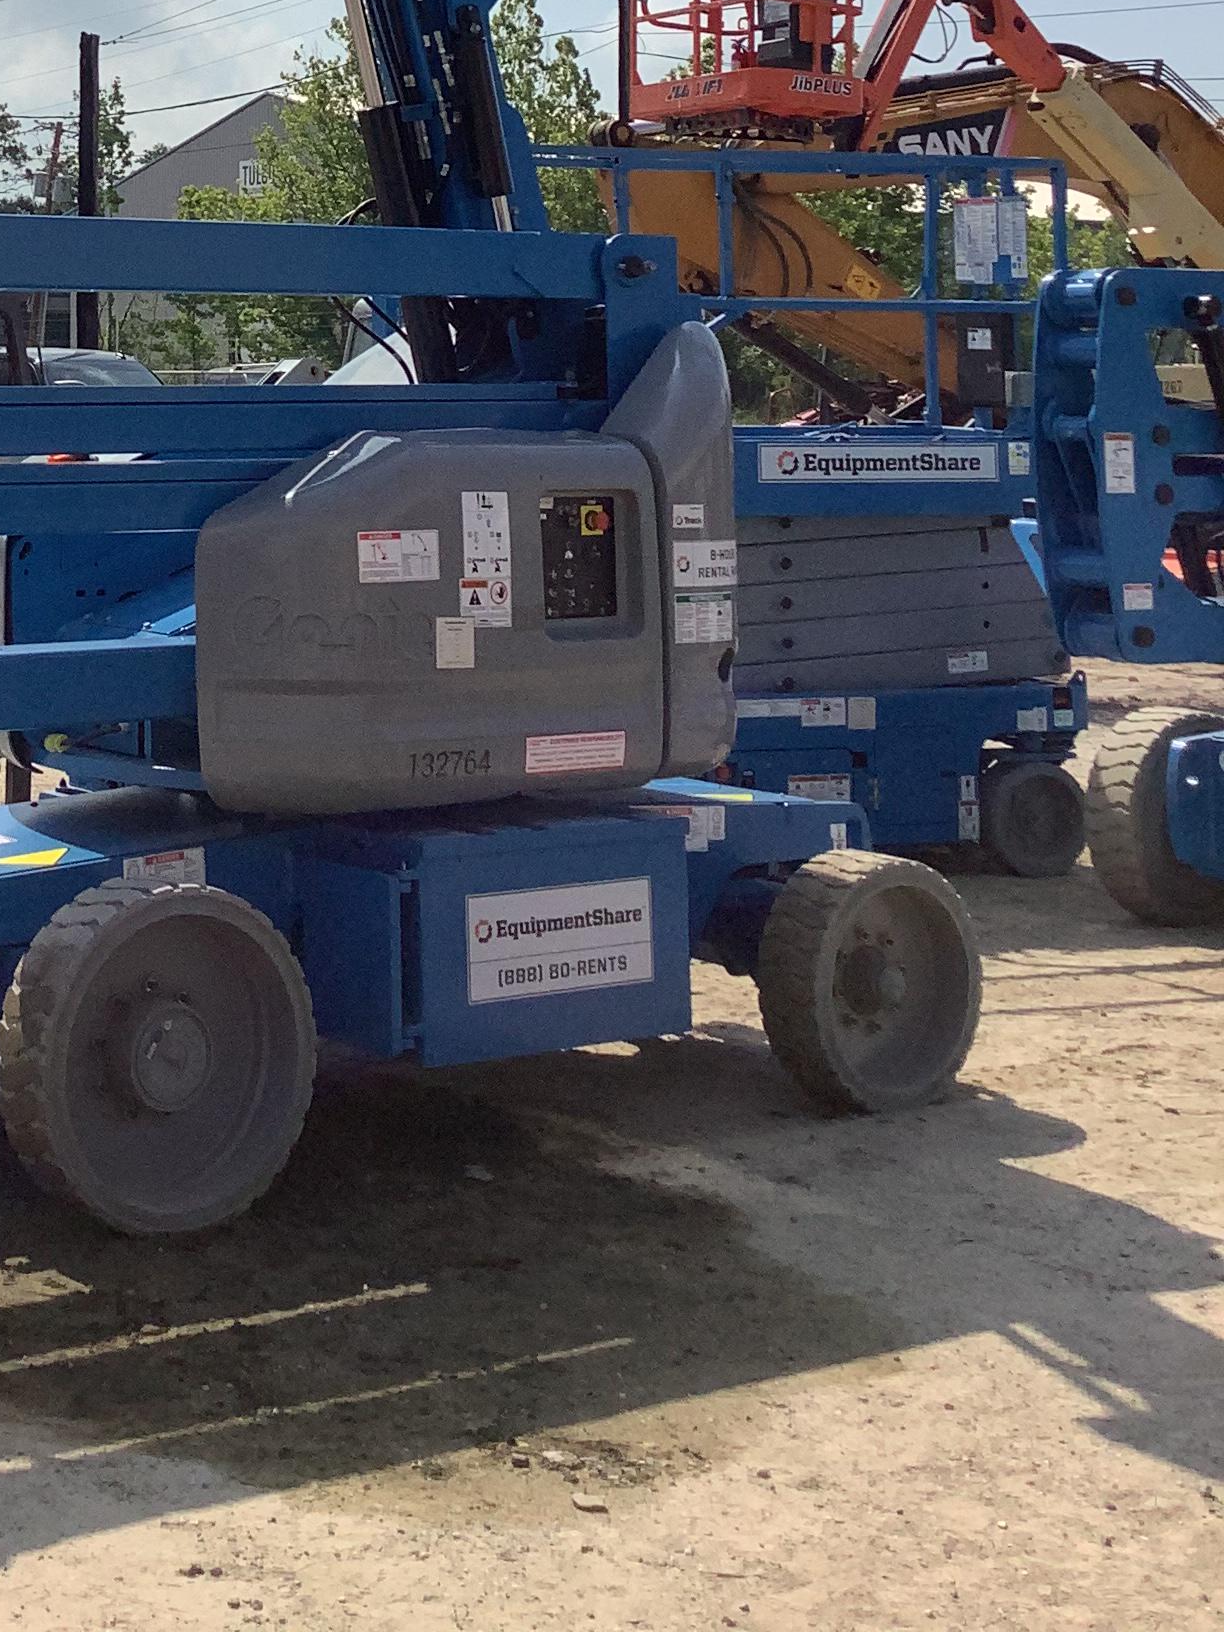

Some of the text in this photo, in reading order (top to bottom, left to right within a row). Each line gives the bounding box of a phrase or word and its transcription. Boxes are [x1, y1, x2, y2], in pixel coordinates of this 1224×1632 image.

[790, 75, 853, 96] JibPLUS
[898, 125, 994, 156] SANY
[803, 452, 981, 476] EquipmentShare
[409, 749, 492, 780] 132764
[495, 907, 643, 941] EquipmentShare
[497, 966, 544, 988] (888)
